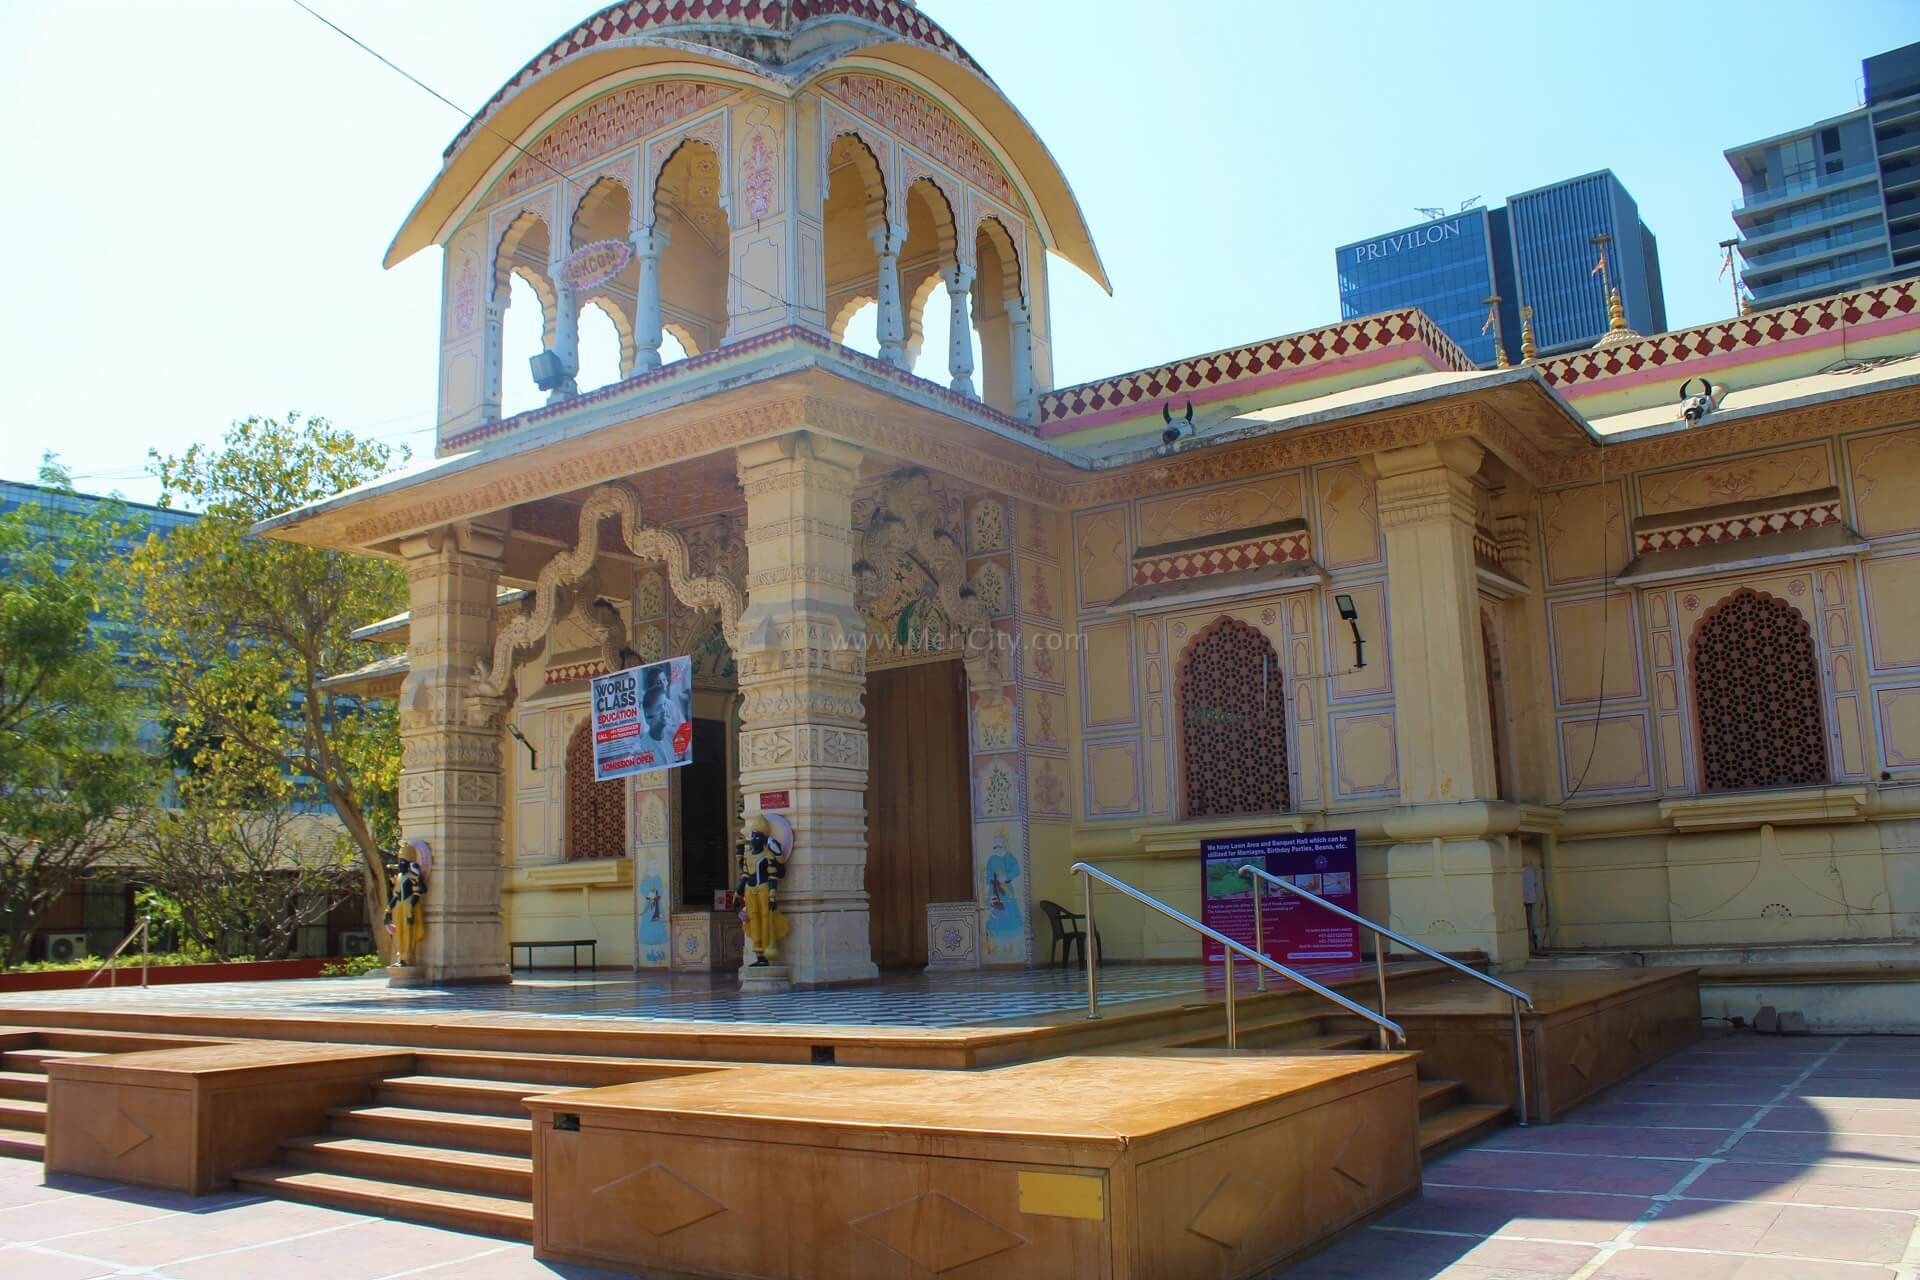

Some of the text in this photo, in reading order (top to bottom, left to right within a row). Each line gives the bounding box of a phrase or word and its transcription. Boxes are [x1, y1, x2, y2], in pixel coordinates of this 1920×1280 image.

[1355, 219, 1460, 264] PRIVILON
[597, 678, 636, 697] WORLD
[597, 691, 636, 712] CLASS
[598, 707, 637, 724] EDUCATION
[602, 755, 655, 770] ADMISSION OPEN
[1267, 847, 1291, 855] Birthday
[1272, 839, 1295, 847] Banquet
